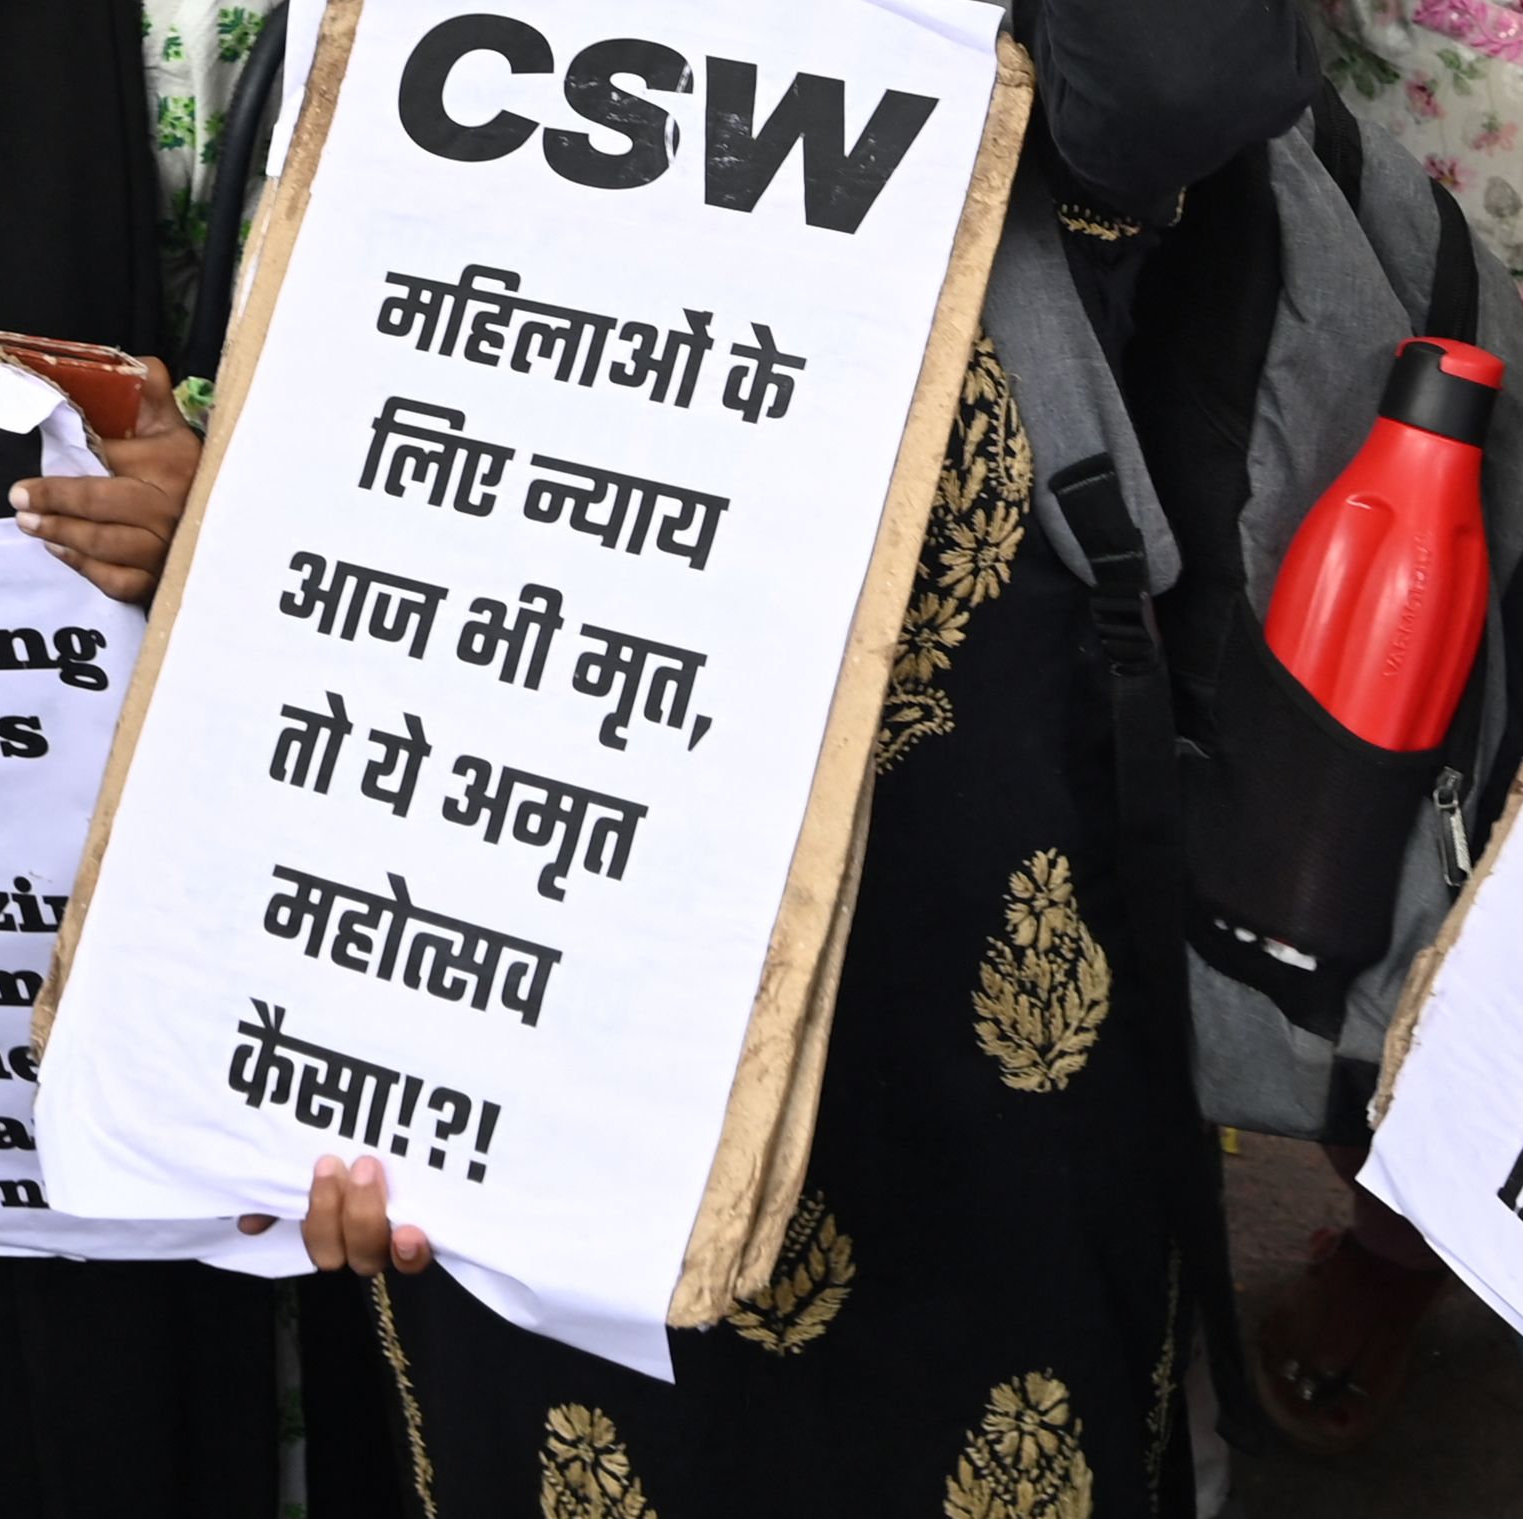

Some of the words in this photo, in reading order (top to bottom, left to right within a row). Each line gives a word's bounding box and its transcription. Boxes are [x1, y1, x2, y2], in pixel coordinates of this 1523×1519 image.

[399, 14, 939, 234] CSW
[377, 265, 714, 408] महिलाओं
[723, 323, 806, 423] के
[359, 397, 515, 516] लिए
[524, 454, 729, 570] न्याय
[280, 552, 448, 659] आज
[457, 584, 564, 690] भी
[573, 624, 711, 750] मृत,
[270, 692, 352, 794] तो
[362, 713, 431, 817] ये
[443, 756, 648, 901] अमृत
[264, 865, 562, 1026] महोत्सव
